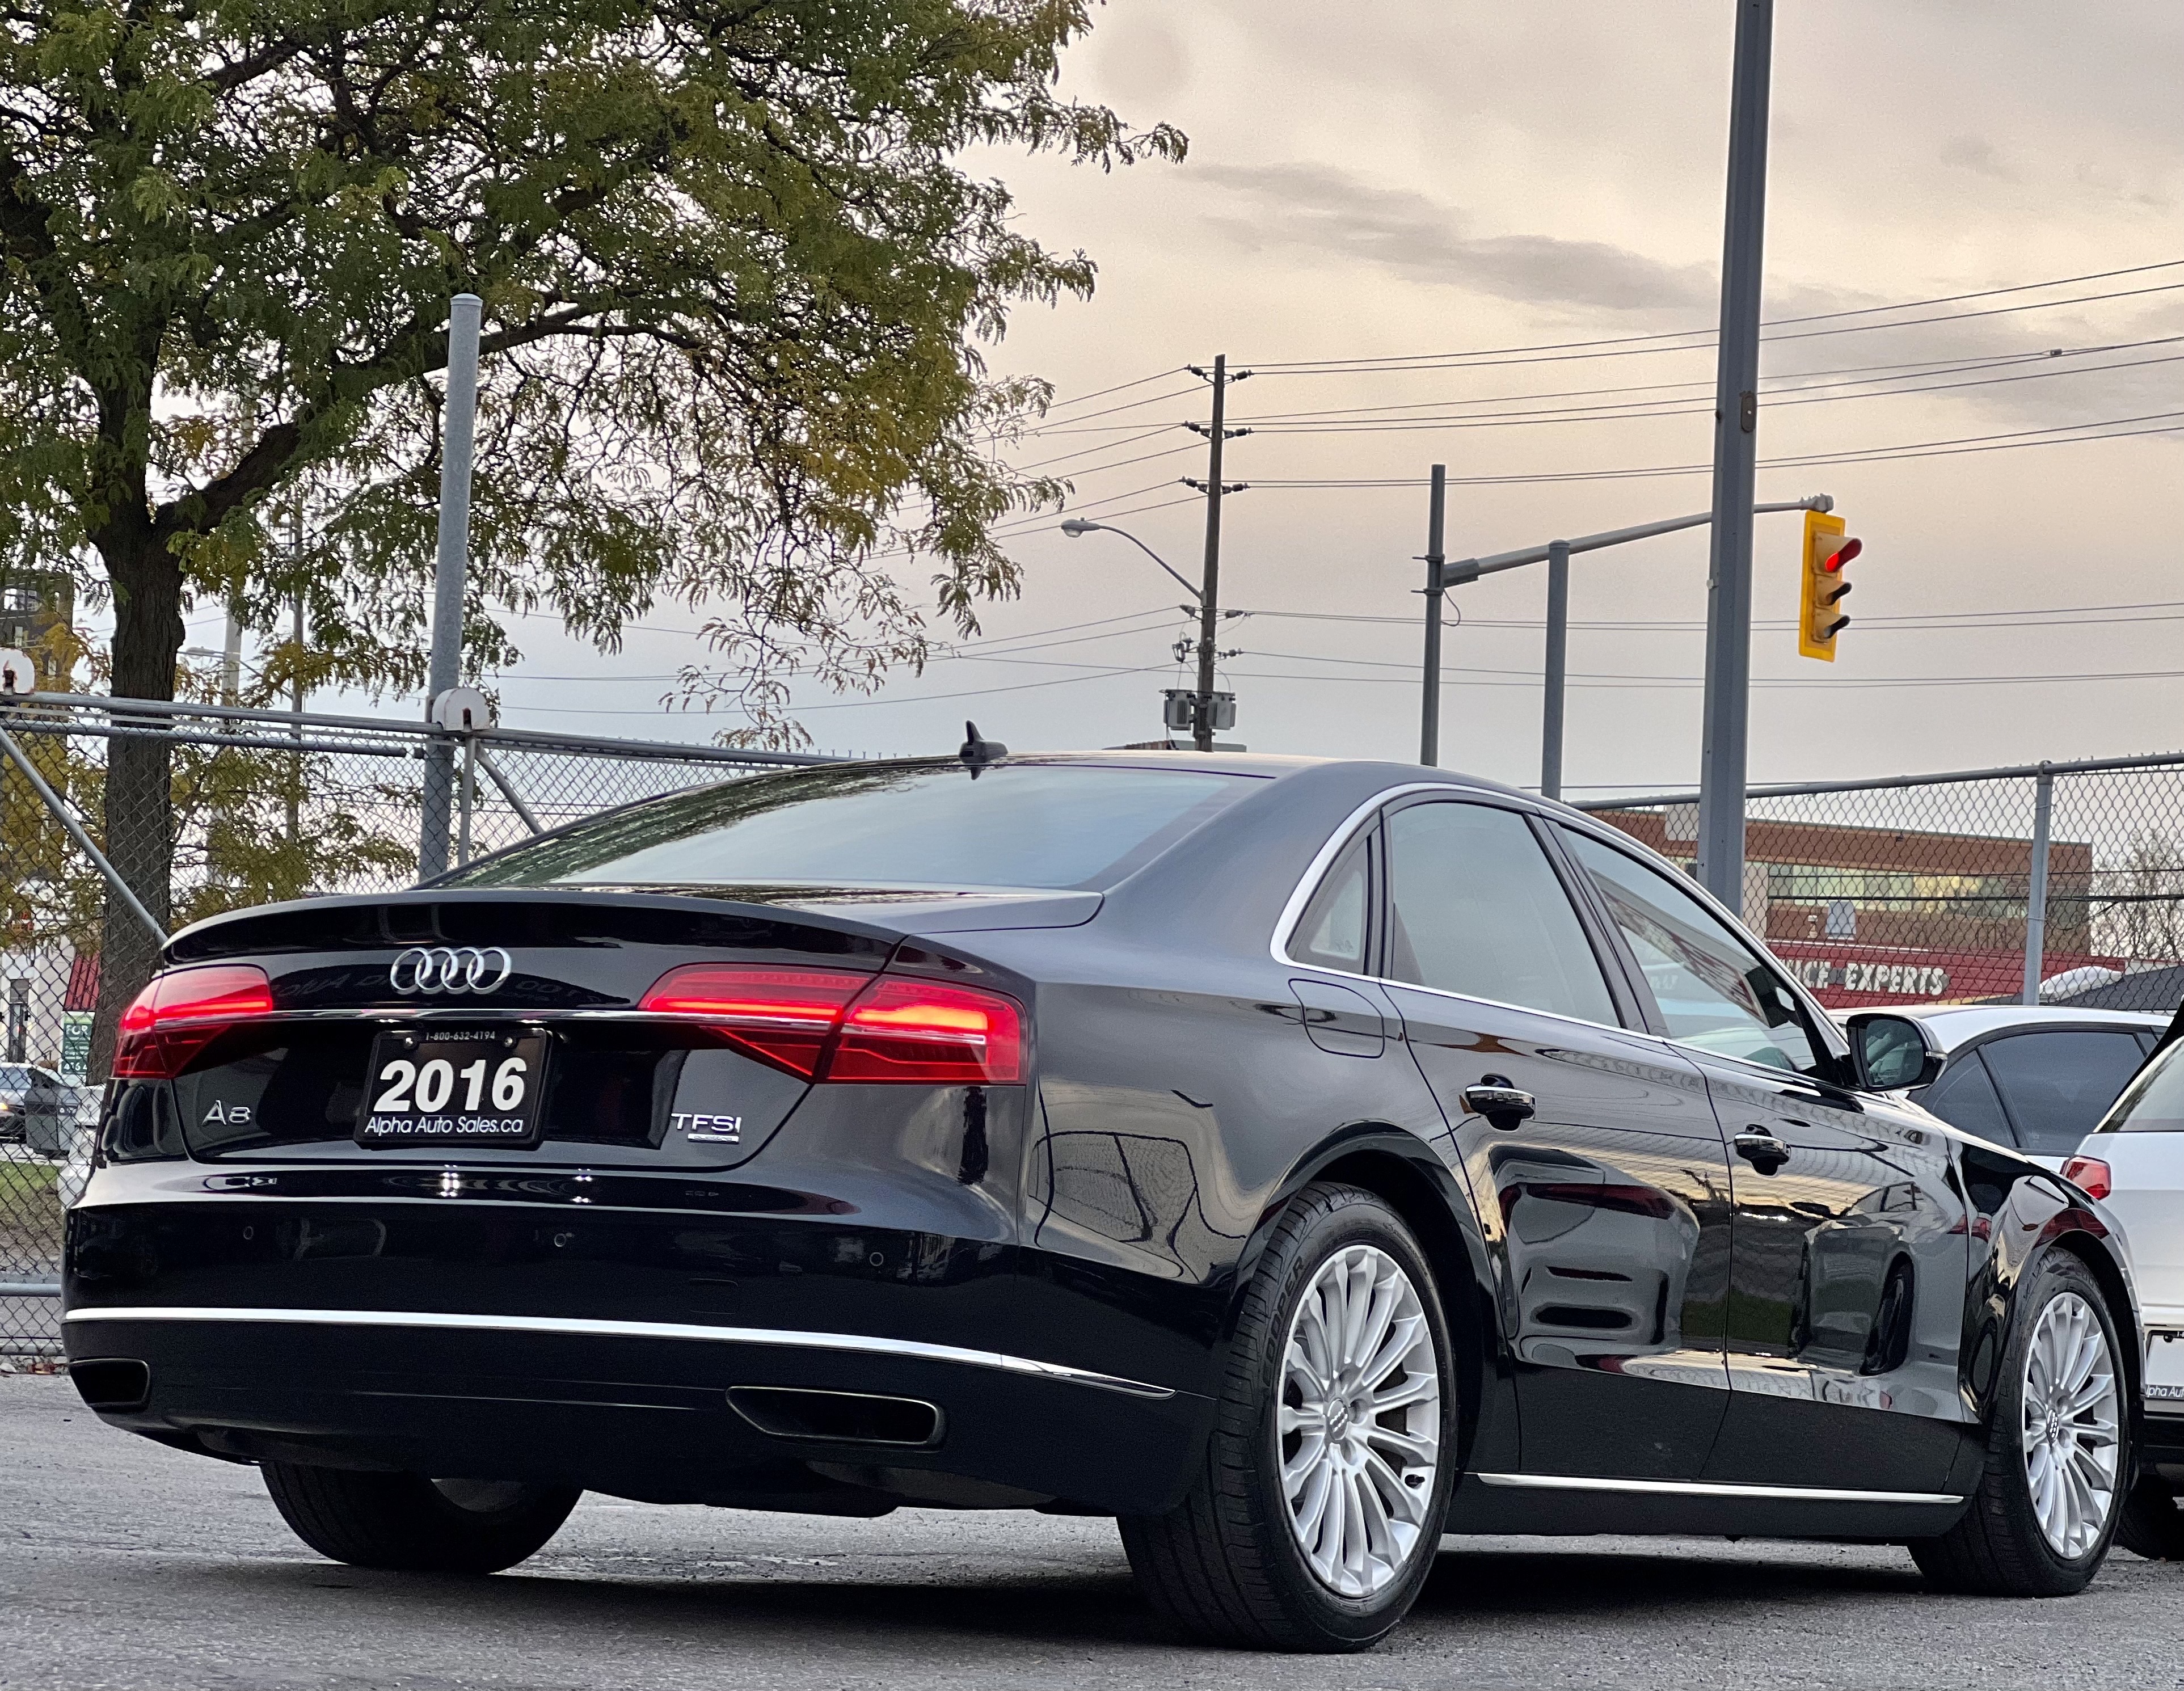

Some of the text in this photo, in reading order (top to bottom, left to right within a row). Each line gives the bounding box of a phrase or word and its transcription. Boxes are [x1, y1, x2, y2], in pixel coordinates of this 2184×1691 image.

[1844, 963, 1945, 996] EXPERTS
[425, 1031, 495, 1041] 1-800-632-4194
[373, 1057, 527, 1112] 2016
[201, 1100, 251, 1125] A8
[671, 1112, 742, 1134] TFSI
[365, 1116, 524, 1136] Alpha Auto Sales.ca
[2146, 1385, 2184, 1398] lpha Aut
